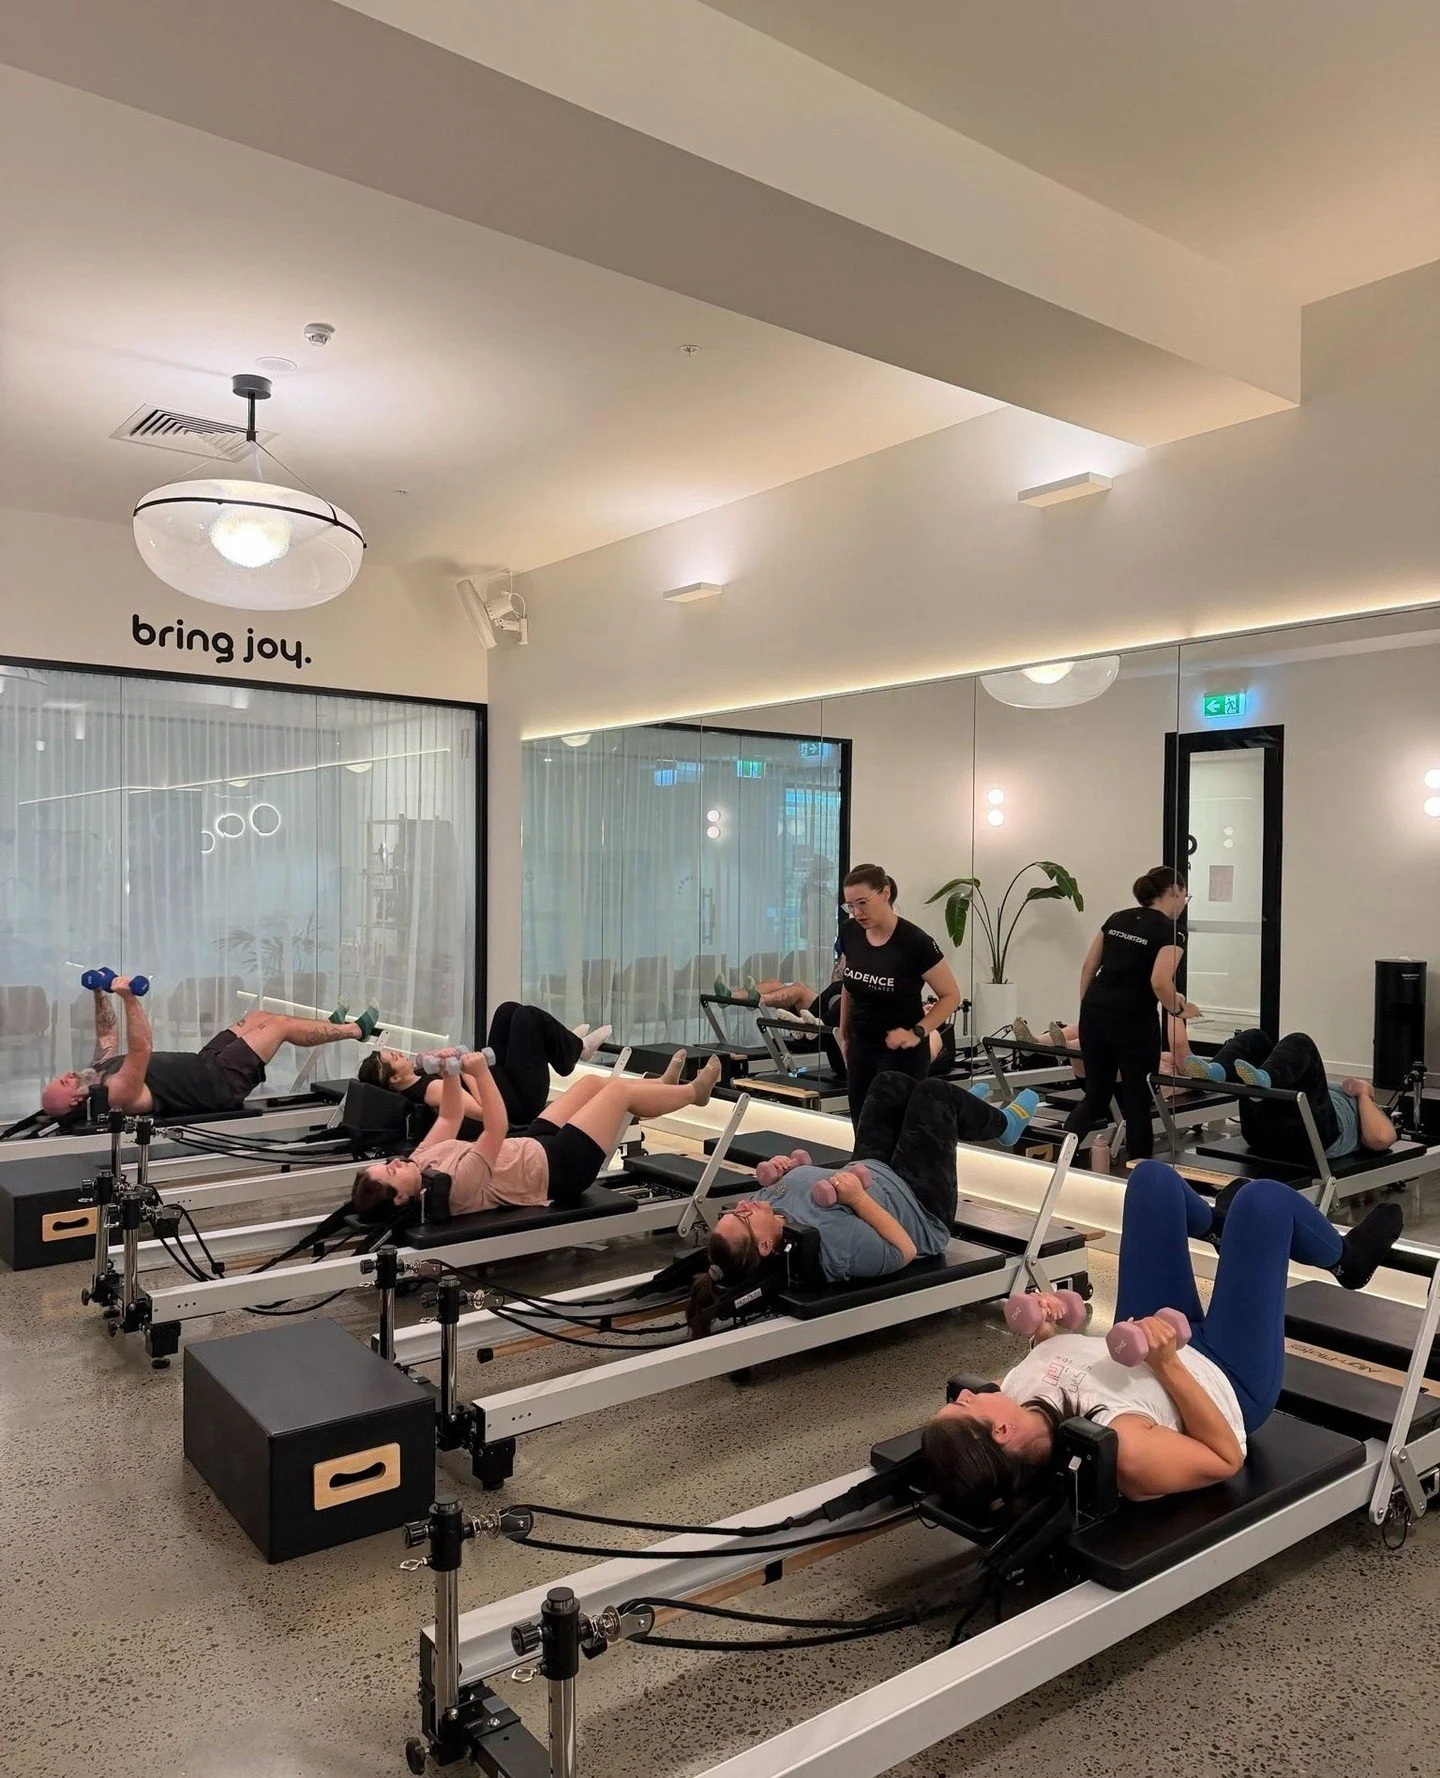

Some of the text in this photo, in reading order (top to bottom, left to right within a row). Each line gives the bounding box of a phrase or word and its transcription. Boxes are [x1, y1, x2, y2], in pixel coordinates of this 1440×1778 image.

[132, 613, 312, 669] bring joy.
[843, 967, 895, 987] CADENCE
